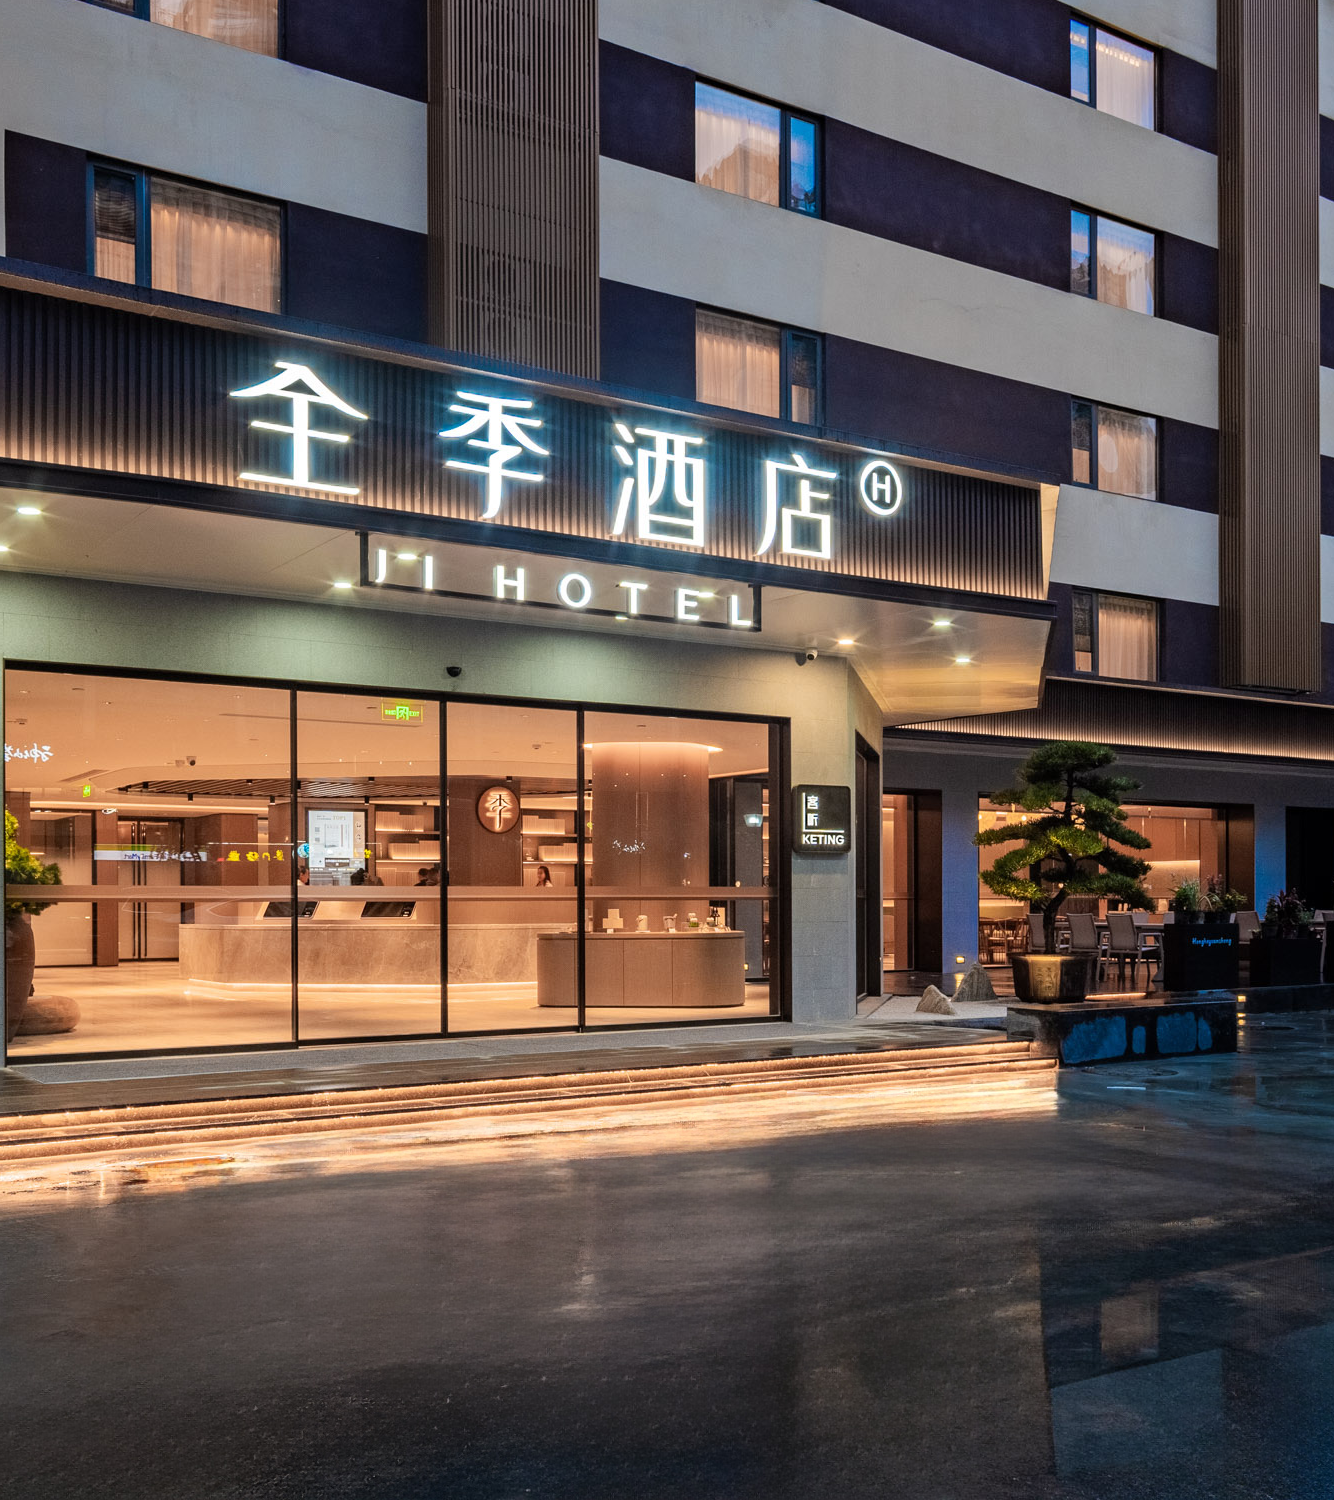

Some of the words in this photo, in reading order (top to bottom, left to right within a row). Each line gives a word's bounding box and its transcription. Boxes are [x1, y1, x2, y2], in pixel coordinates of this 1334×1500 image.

[229, 360, 838, 560] 全季酒店
[375, 548, 434, 590] JI
[493, 564, 753, 627] HOTEL
[484, 790, 513, 830] 季
[802, 833, 845, 845] KETING
